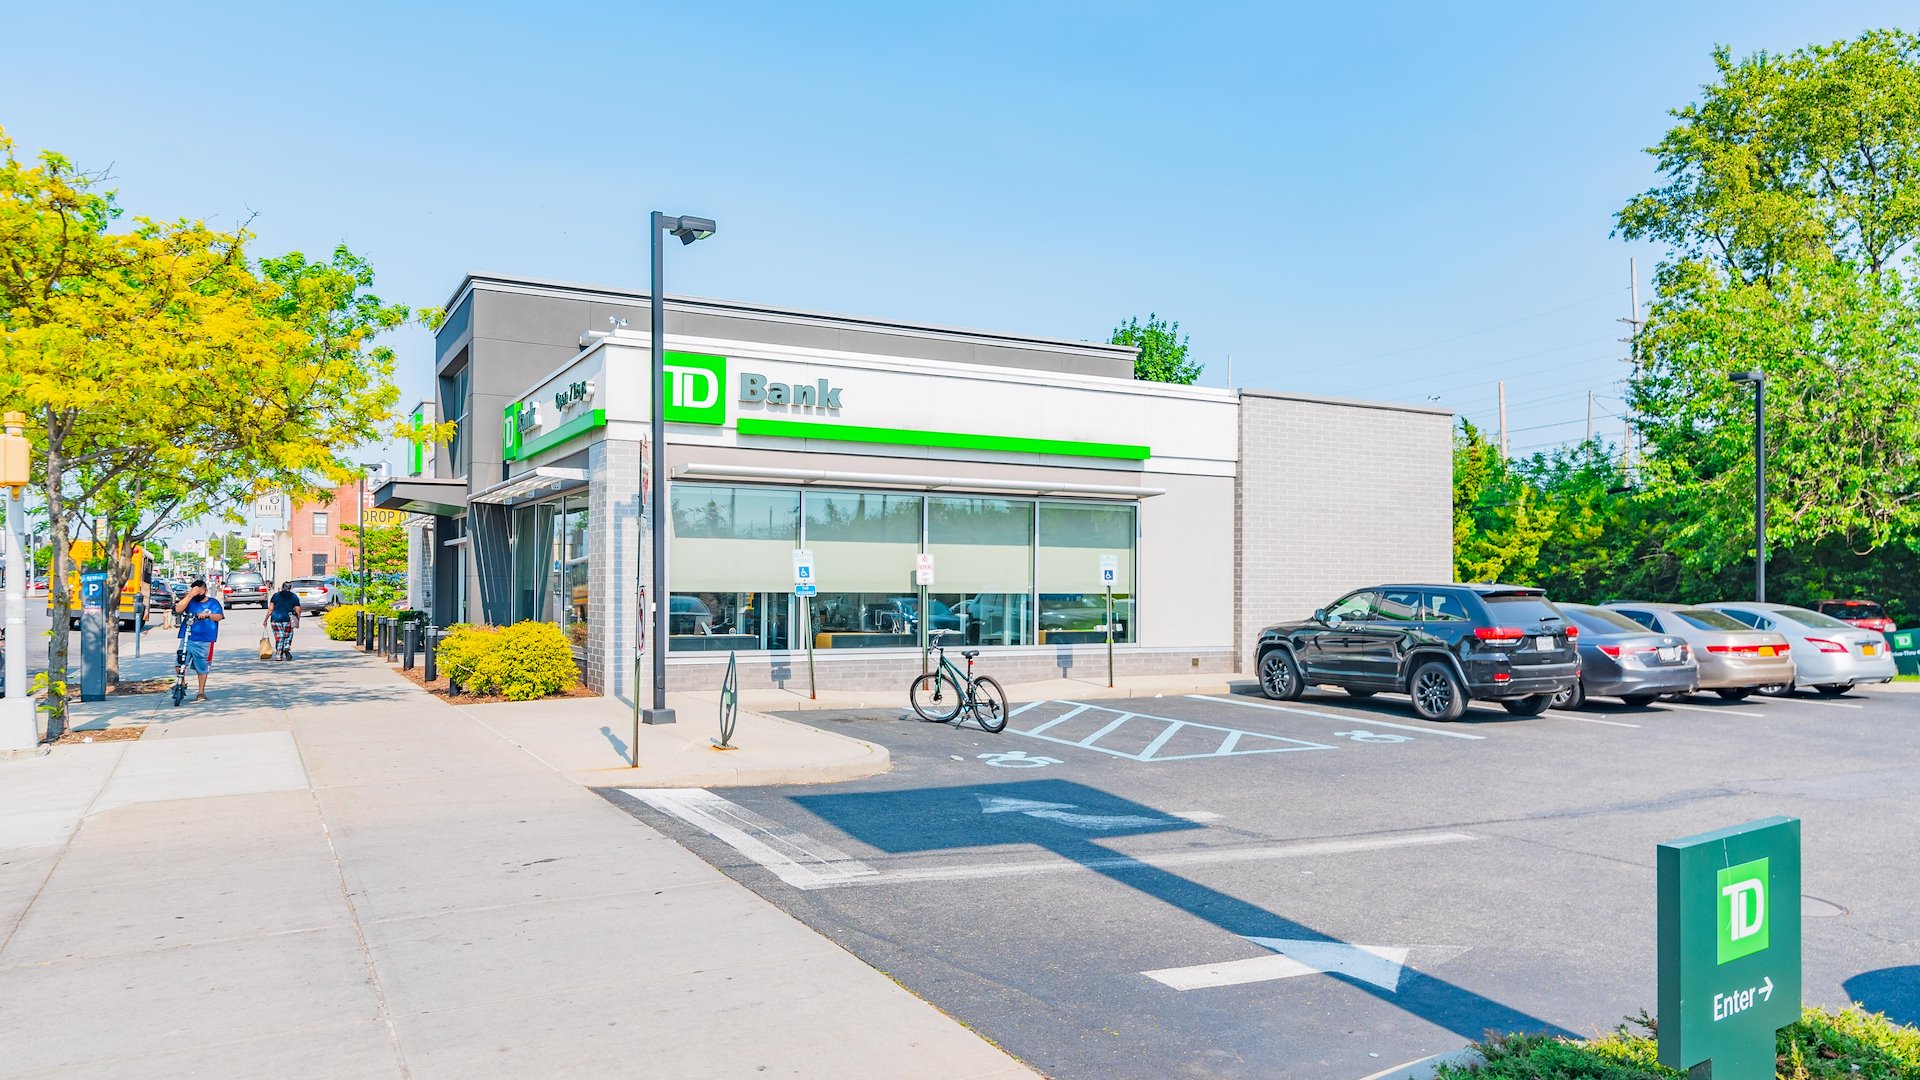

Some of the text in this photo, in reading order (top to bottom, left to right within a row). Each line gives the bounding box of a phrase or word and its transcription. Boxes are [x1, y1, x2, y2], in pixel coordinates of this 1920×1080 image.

[663, 365, 843, 409] TD Bank
[361, 510, 395, 522] DROP
[88, 583, 99, 596] P
[1895, 637, 1911, 646] TD
[1722, 878, 1764, 941] TD
[1713, 986, 1756, 1022] Enter
